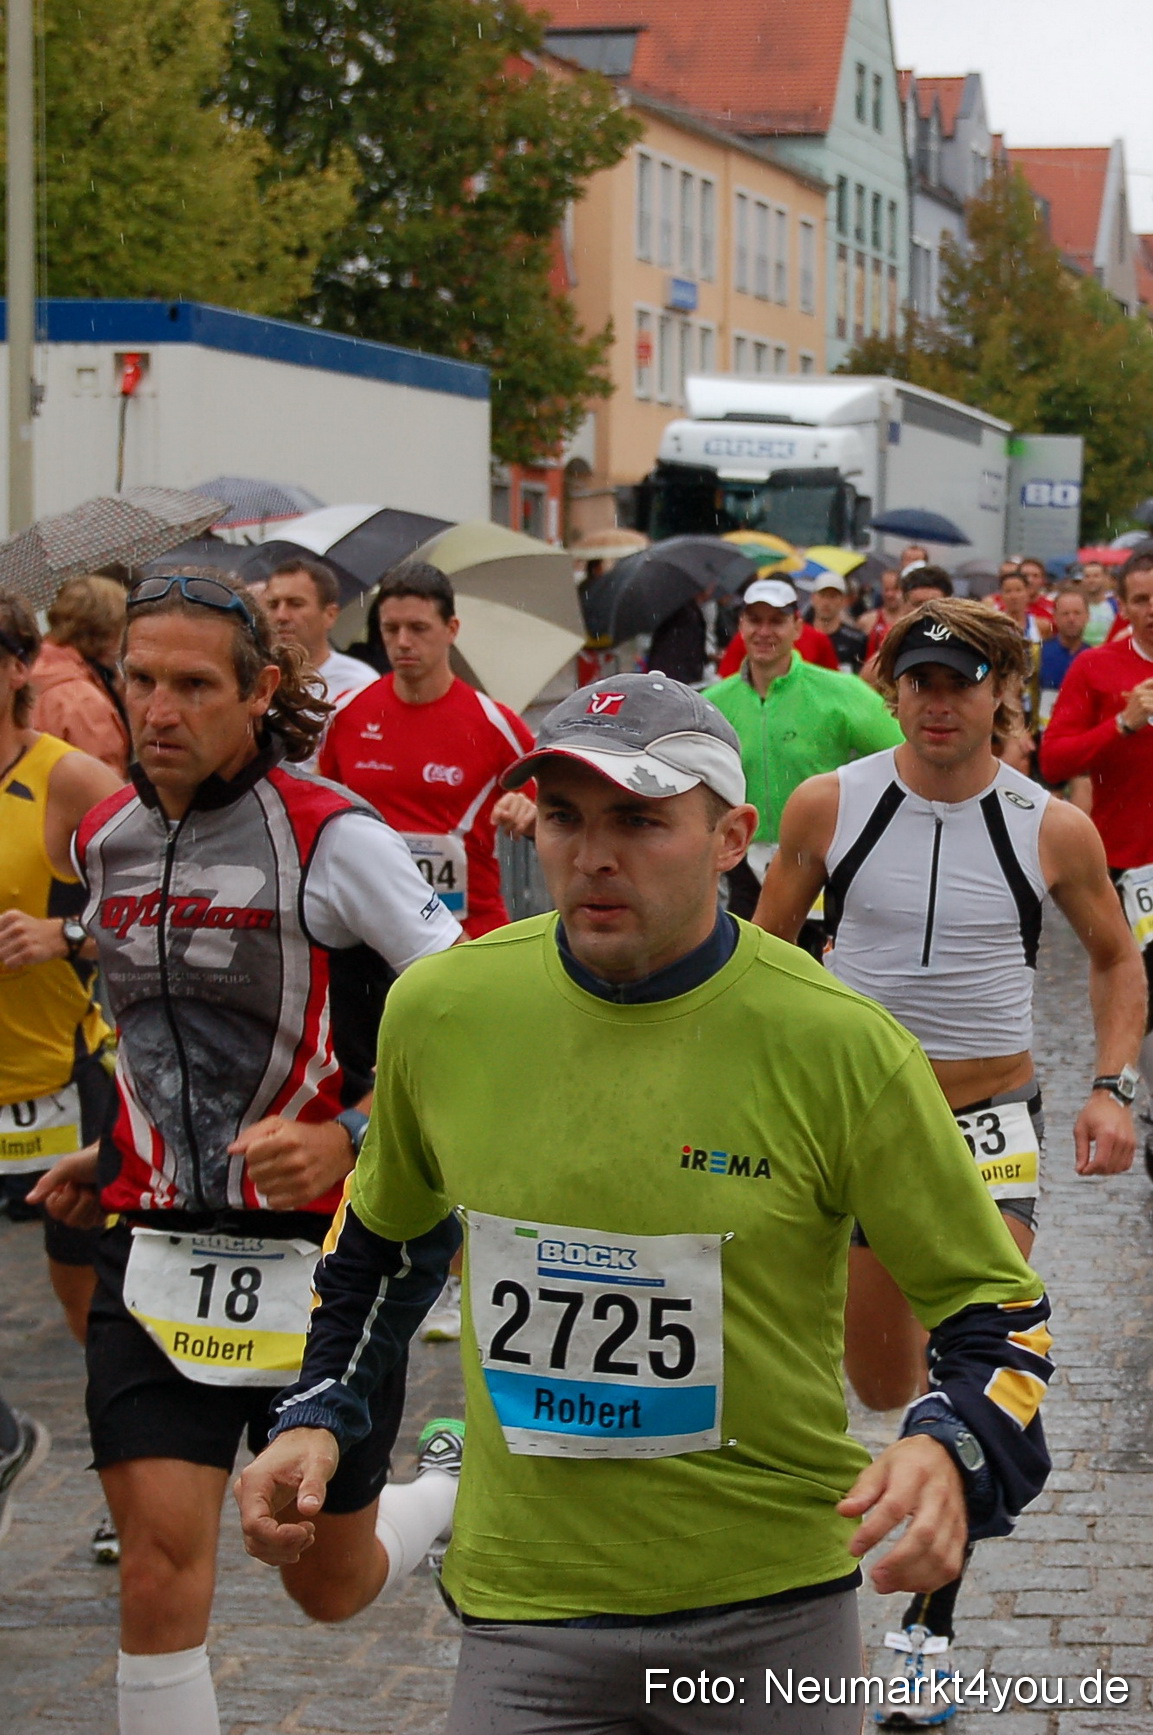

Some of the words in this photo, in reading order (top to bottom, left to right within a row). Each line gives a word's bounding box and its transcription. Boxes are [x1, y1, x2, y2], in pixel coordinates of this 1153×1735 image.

[537, 1239, 638, 1271] BOCK
[190, 1263, 263, 1324] 18
[173, 1330, 255, 1362] Robert
[489, 1279, 696, 1380] 2725
[533, 1387, 642, 1429] Robert
